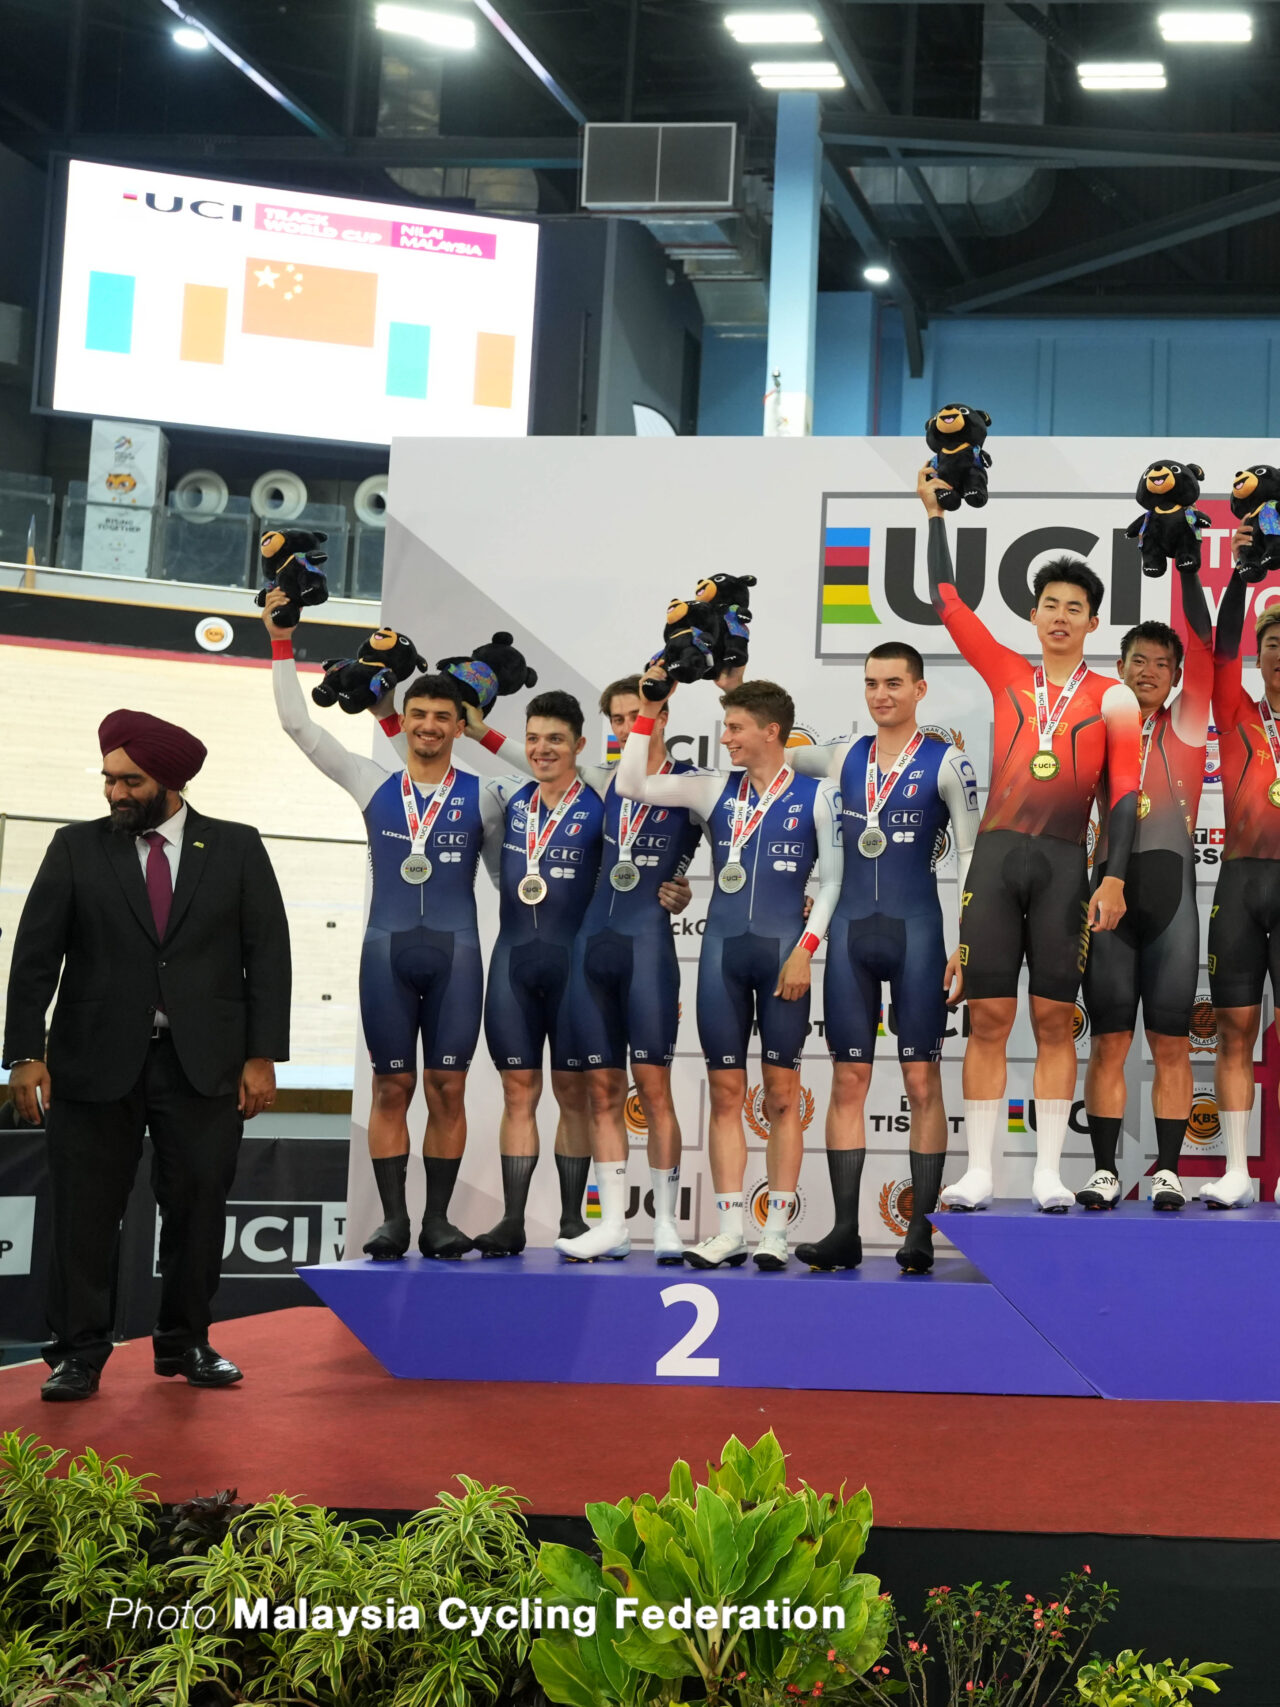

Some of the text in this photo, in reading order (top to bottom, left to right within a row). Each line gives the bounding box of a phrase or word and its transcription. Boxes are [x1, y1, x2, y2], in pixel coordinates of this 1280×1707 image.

[146, 192, 243, 222] UCI
[264, 207, 329, 227] TRACK
[264, 219, 382, 245] WORLD CUP
[400, 224, 444, 240] NILAI
[400, 235, 482, 257] MALAYSIA
[884, 527, 1143, 626] UCI
[665, 735, 709, 768] CI
[960, 760, 978, 805] CIC
[891, 813, 920, 824] CIC
[437, 834, 465, 845] CIC
[771, 844, 801, 855] CIC
[931, 828, 946, 873] FRANCE
[549, 848, 580, 861] CIC
[870, 1115, 965, 1133] TIST
[655, 1283, 720, 1377] 2
